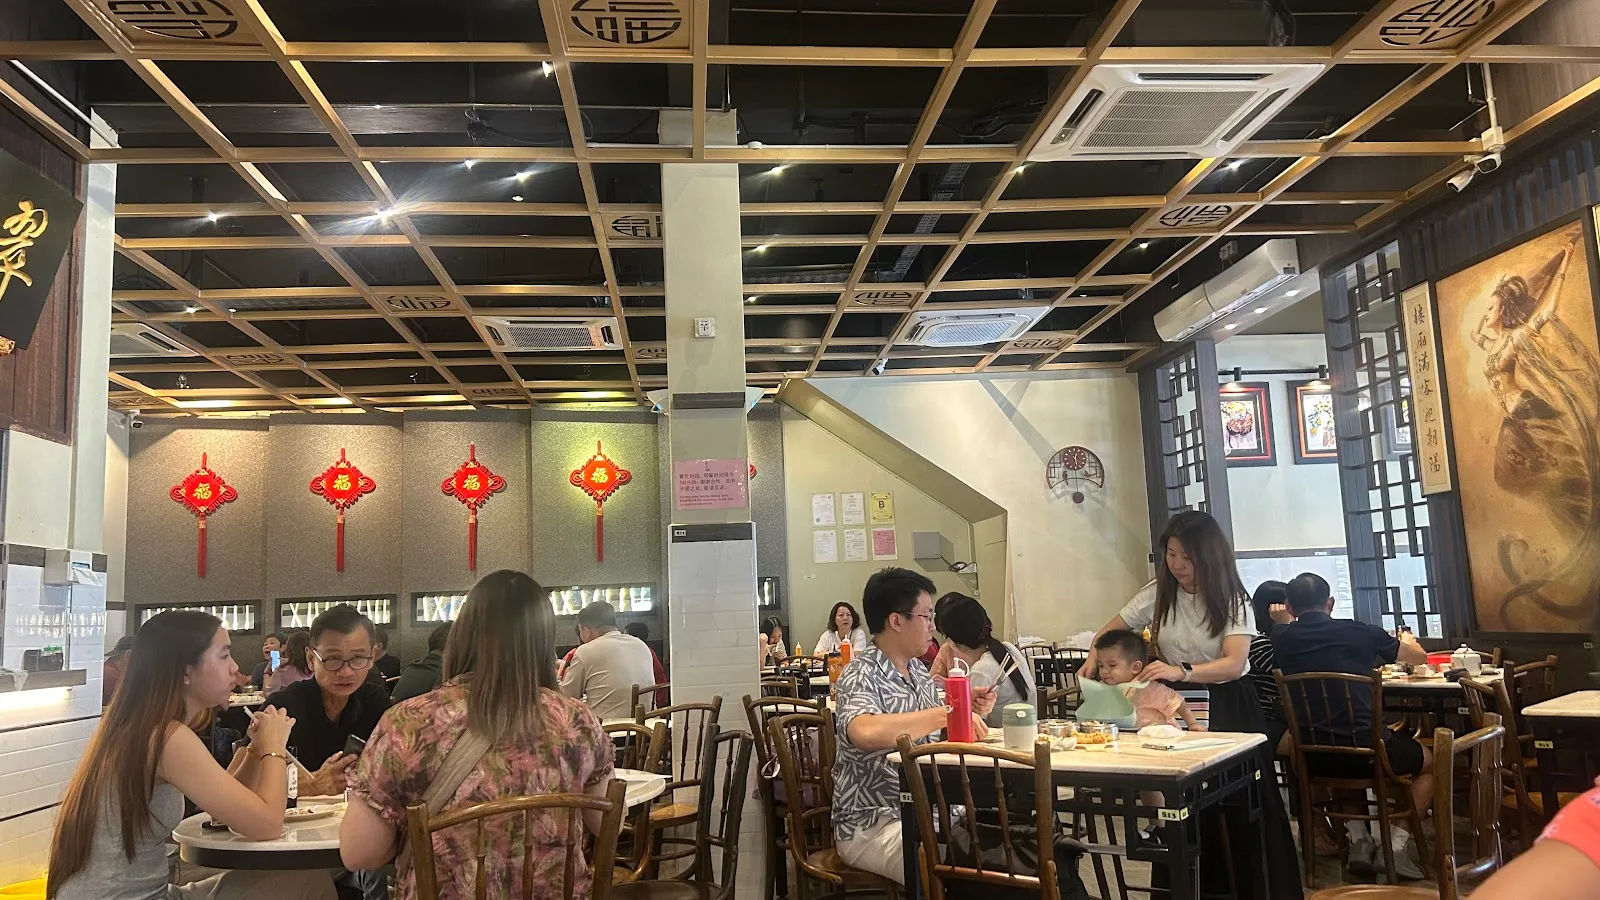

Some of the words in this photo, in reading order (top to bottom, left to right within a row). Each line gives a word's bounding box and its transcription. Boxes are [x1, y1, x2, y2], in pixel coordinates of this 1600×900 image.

[333, 474, 351, 491] 福
[463, 474, 480, 491] 福
[591, 467, 608, 483] 福
[193, 482, 212, 500] 福
[878, 500, 885, 508] B
[1161, 811, 1177, 819] S13
